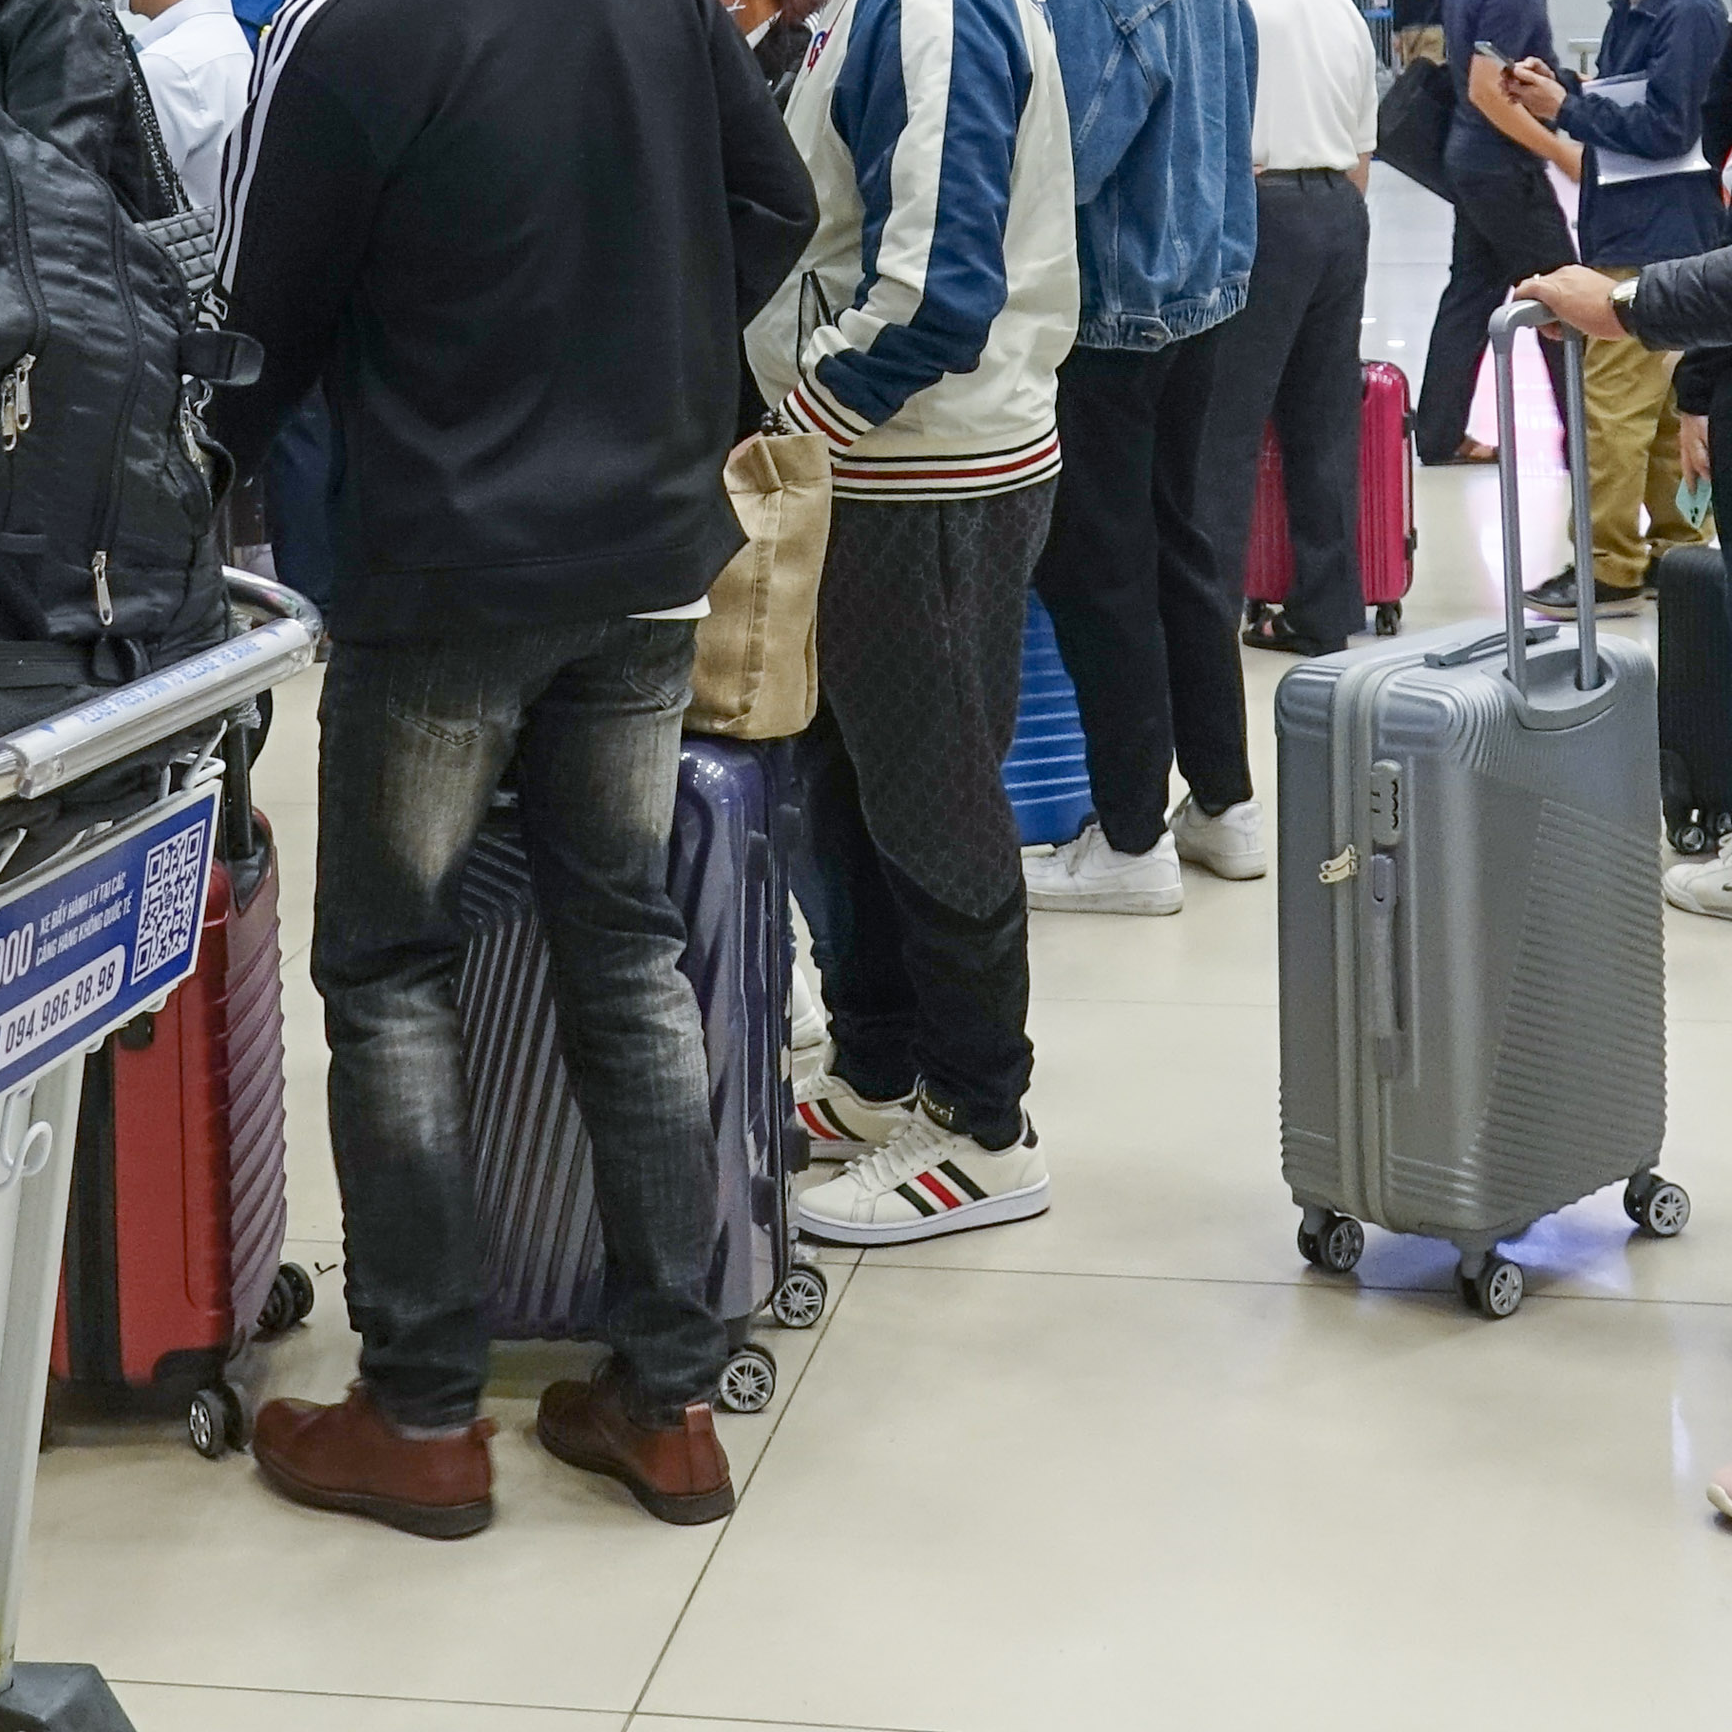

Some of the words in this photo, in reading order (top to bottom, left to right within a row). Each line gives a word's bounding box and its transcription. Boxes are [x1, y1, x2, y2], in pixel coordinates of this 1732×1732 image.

[36, 936, 57, 967] CẢNG
[57, 925, 78, 956] HÀNG
[79, 912, 103, 946] KHÔNG
[39, 913, 52, 936] XE
[67, 890, 89, 924] HÀNH
[5, 960, 116, 1054] 094.986.98.98
